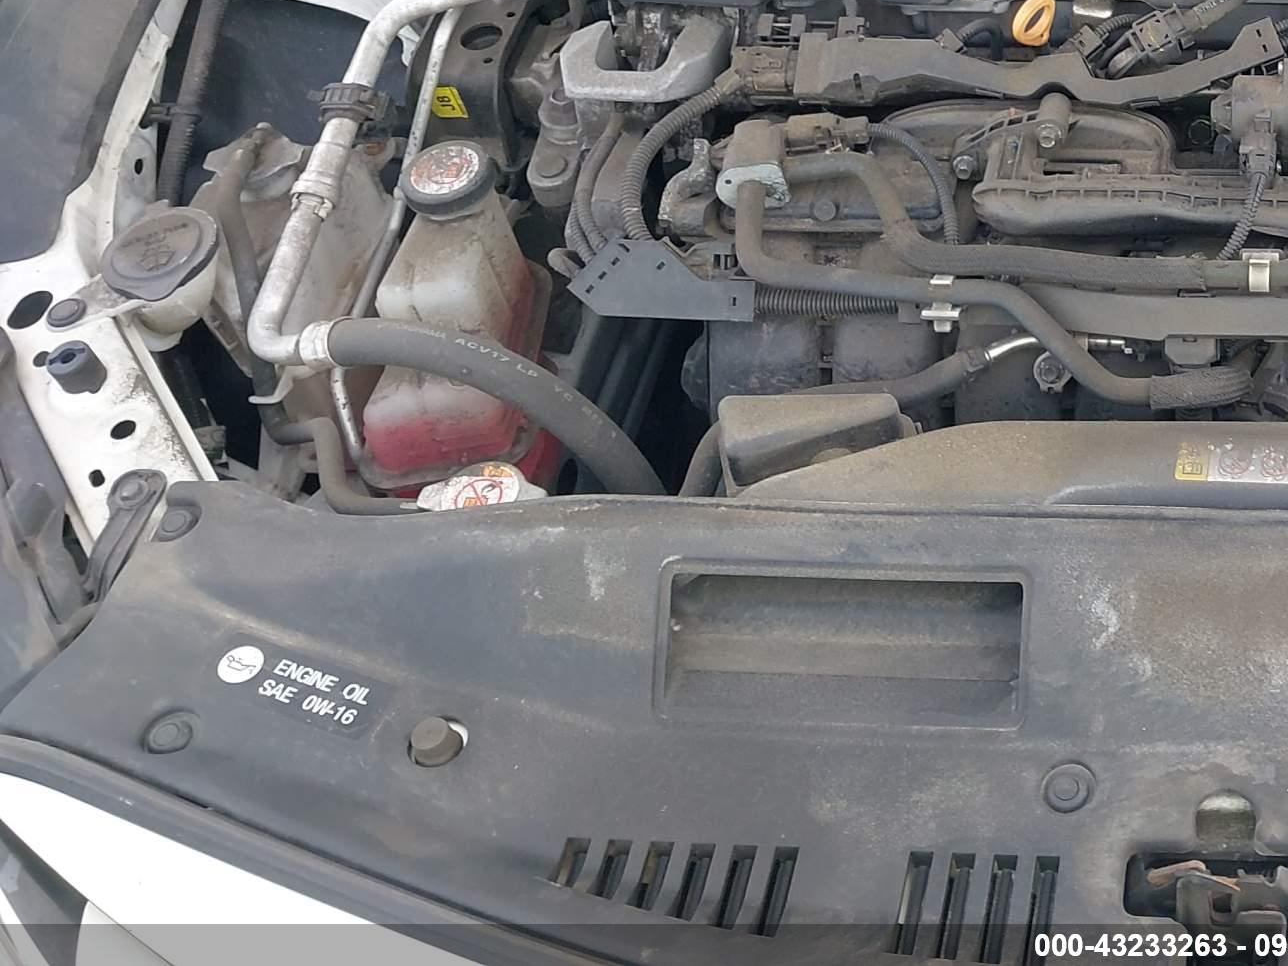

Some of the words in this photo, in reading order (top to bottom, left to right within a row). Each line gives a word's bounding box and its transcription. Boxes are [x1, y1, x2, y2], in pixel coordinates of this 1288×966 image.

[258, 679, 298, 703] SAE
[302, 695, 357, 725] 0W-16
[273, 659, 339, 692] ENGINE
[342, 684, 370, 705] OIL
